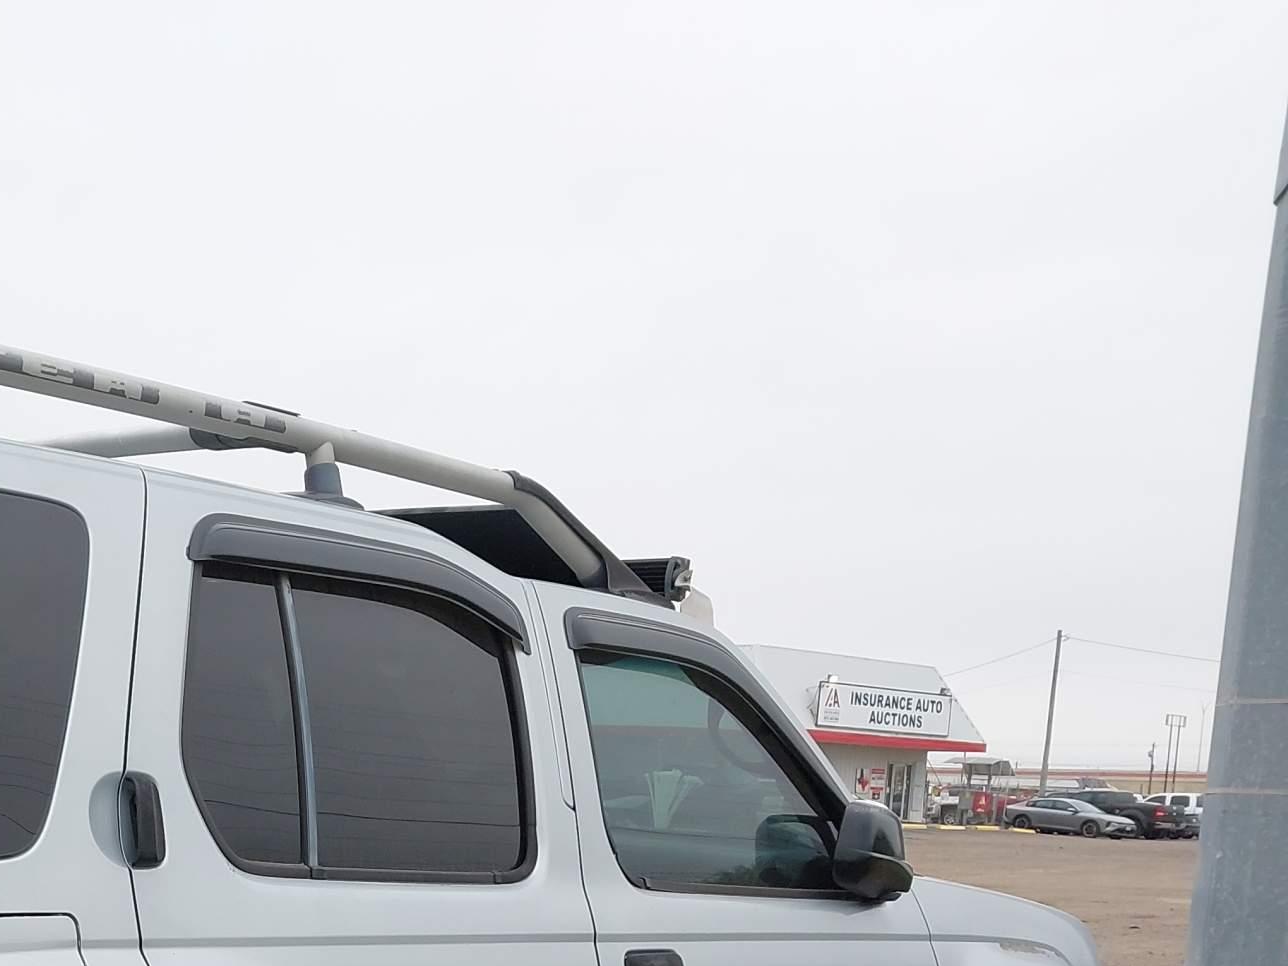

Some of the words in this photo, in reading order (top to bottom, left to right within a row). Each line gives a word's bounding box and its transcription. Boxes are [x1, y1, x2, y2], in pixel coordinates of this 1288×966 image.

[850, 690, 913, 711] INSURANCE
[915, 698, 943, 714] AUTO
[868, 710, 923, 729] AUCTIONS
